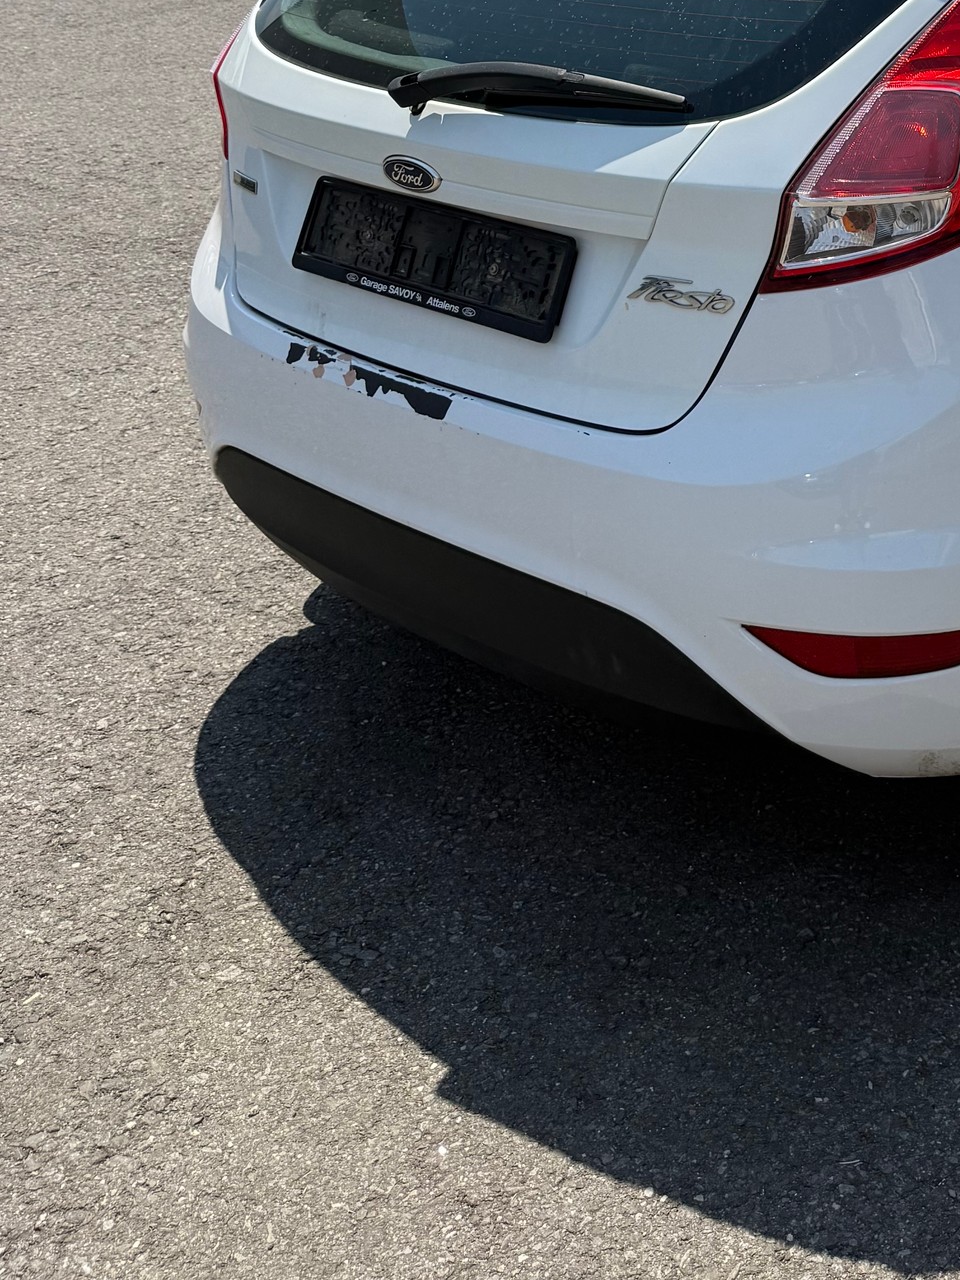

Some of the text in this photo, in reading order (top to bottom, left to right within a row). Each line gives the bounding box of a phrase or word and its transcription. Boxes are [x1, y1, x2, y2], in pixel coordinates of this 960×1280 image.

[391, 163, 424, 186] Ford
[360, 276, 388, 292] Garage
[388, 284, 416, 301] SAVOY
[426, 296, 460, 314] Attalens
[627, 275, 735, 314] Fiesta
